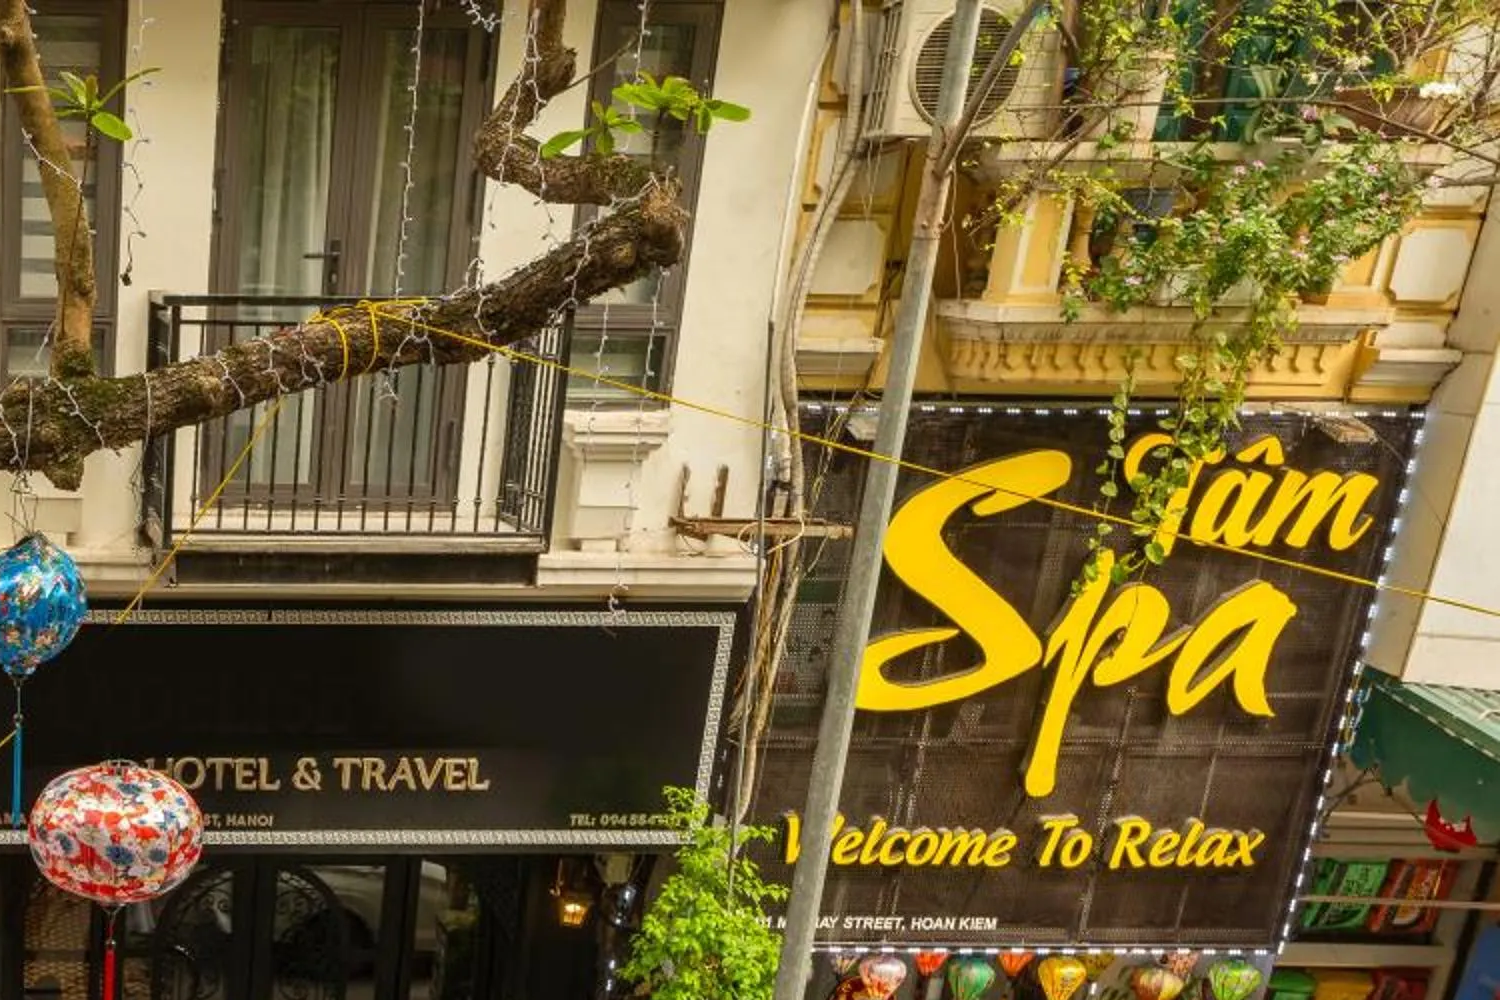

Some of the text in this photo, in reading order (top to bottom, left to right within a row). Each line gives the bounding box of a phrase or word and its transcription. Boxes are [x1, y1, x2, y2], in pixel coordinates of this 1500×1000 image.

[855, 449, 1298, 799] Spa
[292, 757, 322, 791] &
[333, 757, 491, 791] TRAVEL
[225, 813, 274, 828] HANOI
[1038, 814, 1093, 869] To
[1109, 815, 1266, 870] Relax
[843, 916, 906, 931] STREET,
[911, 916, 956, 930] HOAN
[958, 916, 998, 930] KIEM
